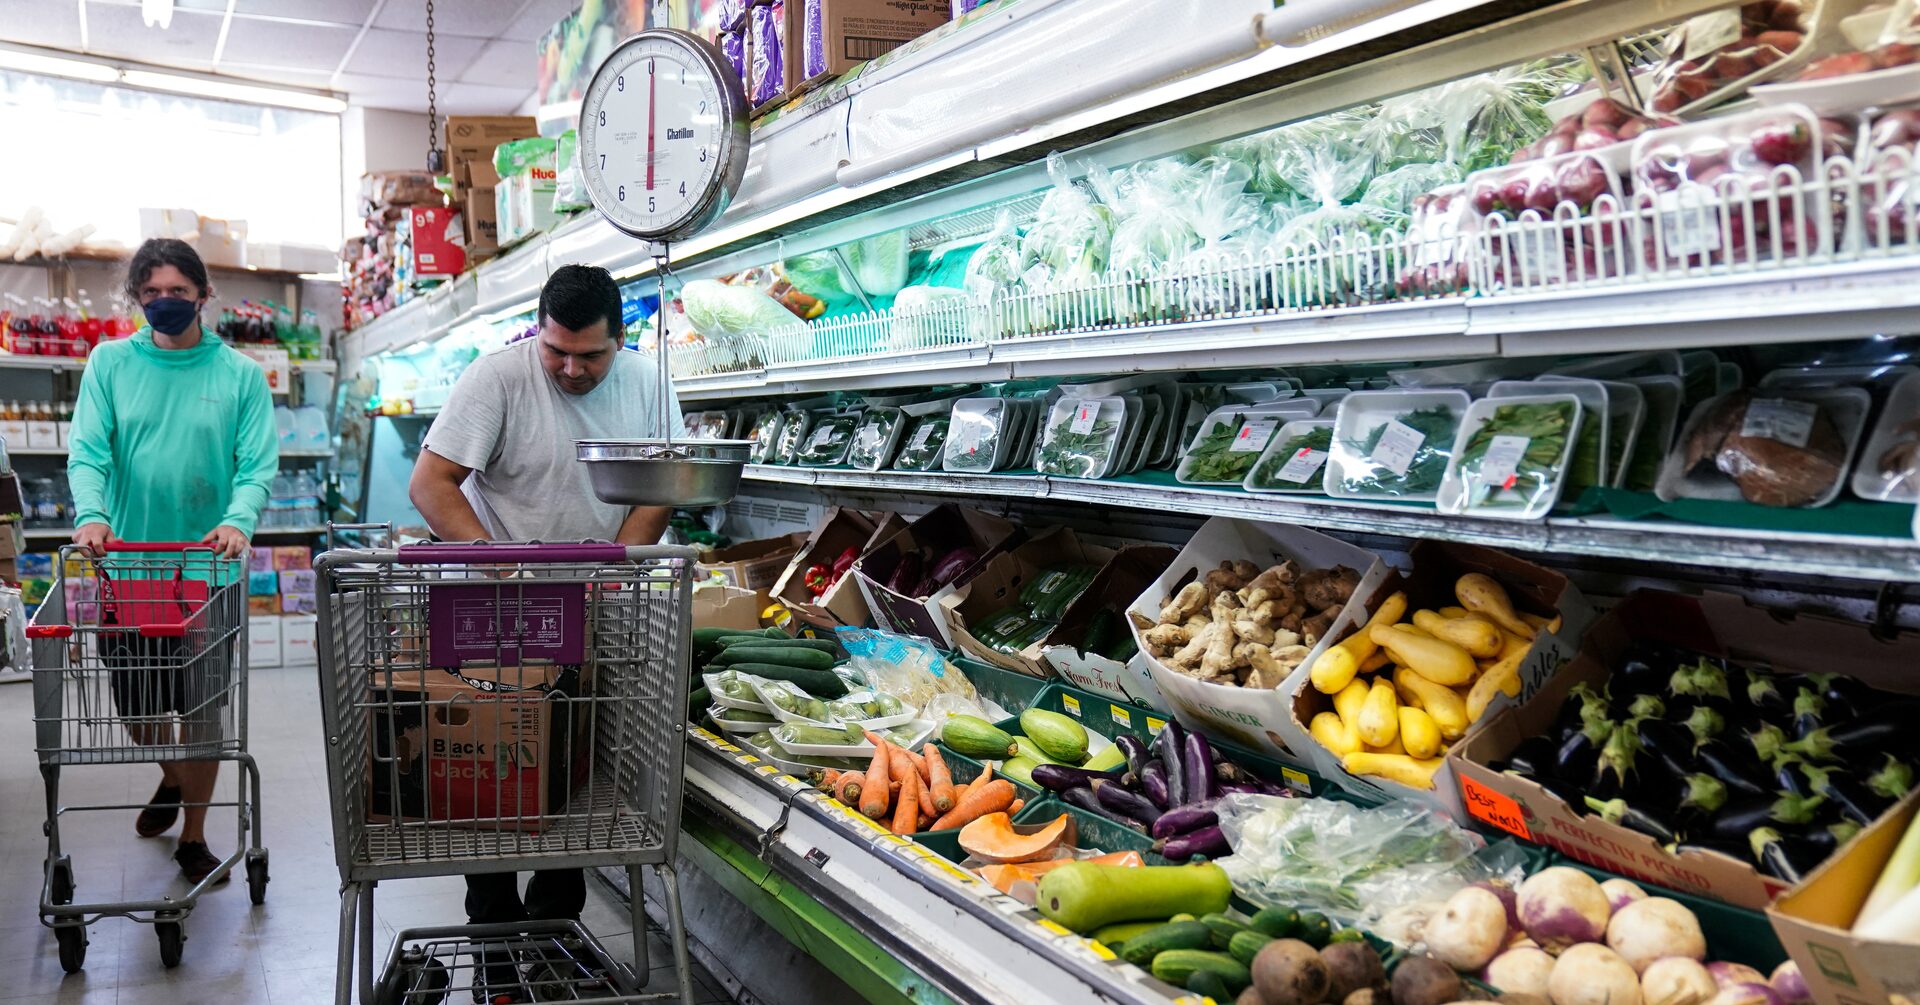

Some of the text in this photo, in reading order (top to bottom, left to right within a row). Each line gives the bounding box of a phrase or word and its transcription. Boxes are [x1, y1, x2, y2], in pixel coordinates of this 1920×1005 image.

[648, 61, 655, 75] 0
[618, 76, 624, 92] 9
[700, 101, 706, 115] 2
[600, 111, 606, 127] 8
[667, 128, 694, 140] Chatillon
[600, 155, 606, 170] 7
[700, 148, 706, 162] 3
[618, 186, 625, 201] 6
[679, 181, 686, 197] 4
[649, 196, 655, 213] 5
[1198, 703, 1264, 728] GINGER
[434, 761, 489, 780] Jack
[1551, 815, 1636, 863] PERFECTLY
[1642, 851, 1712, 891] PICKED
